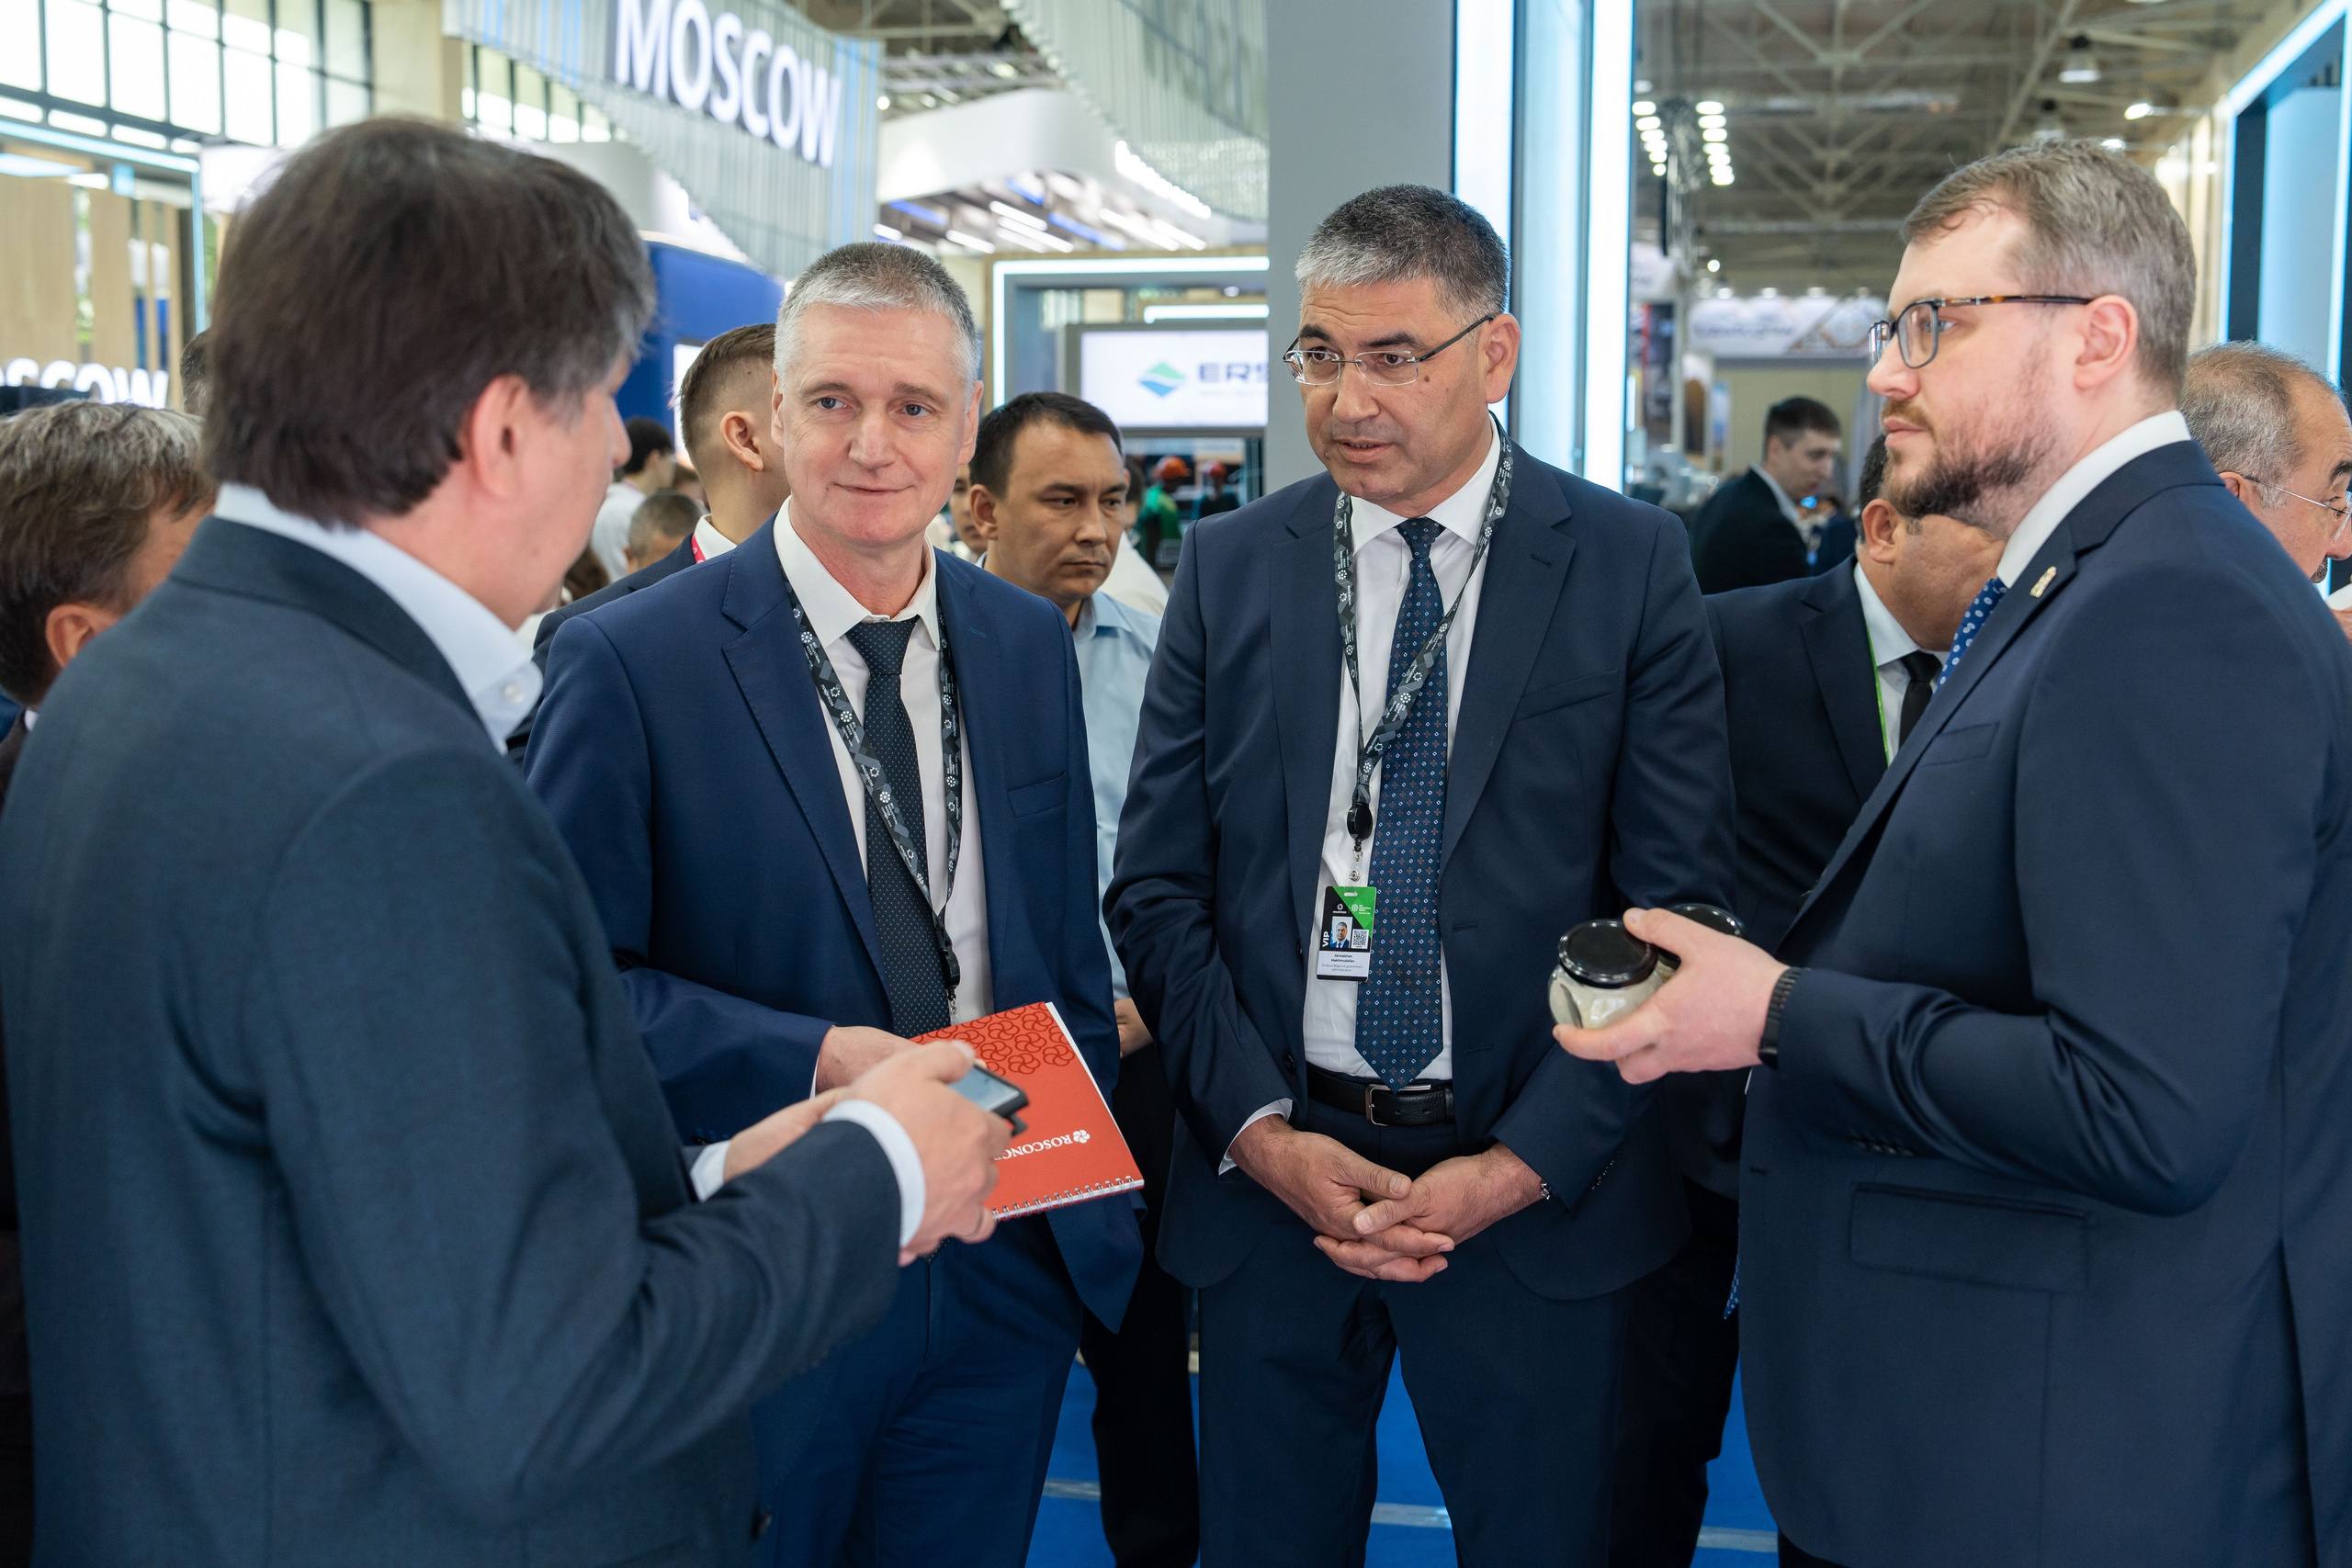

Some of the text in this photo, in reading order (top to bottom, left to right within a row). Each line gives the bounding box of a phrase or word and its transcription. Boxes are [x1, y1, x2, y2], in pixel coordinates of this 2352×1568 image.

[615, 0, 842, 169] MOSCOW
[809, 643, 820, 664] INDUSTRIAL
[1405, 664, 1417, 684] INNOPROM
[821, 684, 834, 707] INNOPROM
[1392, 703, 1403, 722] INDUSTRIAL
[849, 723, 860, 743] INDUSTRIAL
[1366, 735, 1379, 754] INNOPROM
[861, 764, 874, 787] INNOPROM
[887, 804, 897, 825] INDUSTRIAL
[900, 845, 912, 867] INNOPROM
[994, 1134, 1073, 1160] ROSCONG
